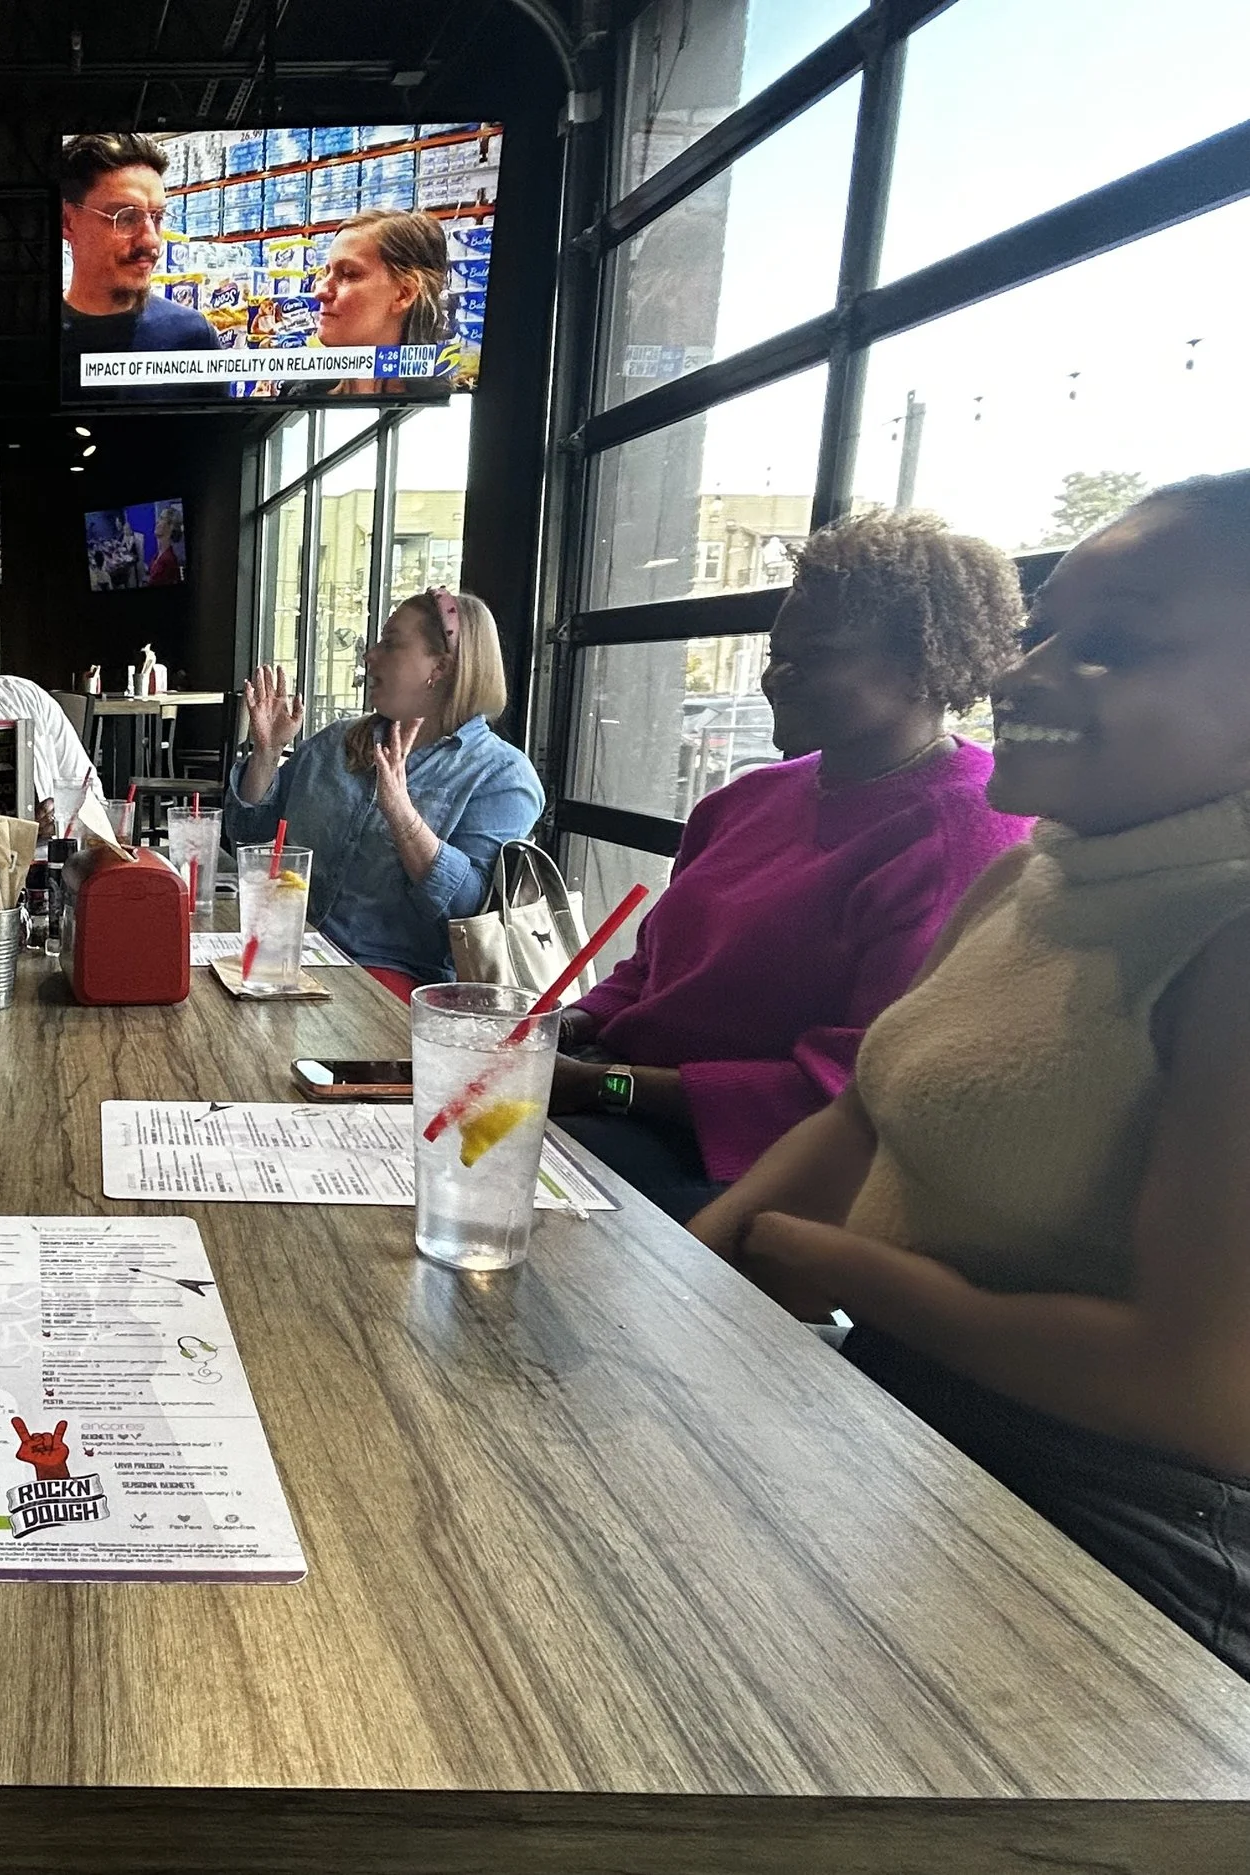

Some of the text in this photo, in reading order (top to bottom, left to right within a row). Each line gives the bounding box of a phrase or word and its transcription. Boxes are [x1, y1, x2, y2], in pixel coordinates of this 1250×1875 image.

[401, 346, 435, 361] ACTION
[85, 355, 373, 377] IMPACT OF FINANCIAL INFIDELITY ON RELATIONSHIPS
[400, 361, 428, 375] NEWS
[81, 1422, 145, 1431] encores
[18, 1479, 91, 1504] ROCKN
[22, 1501, 99, 1528] DOUGH
